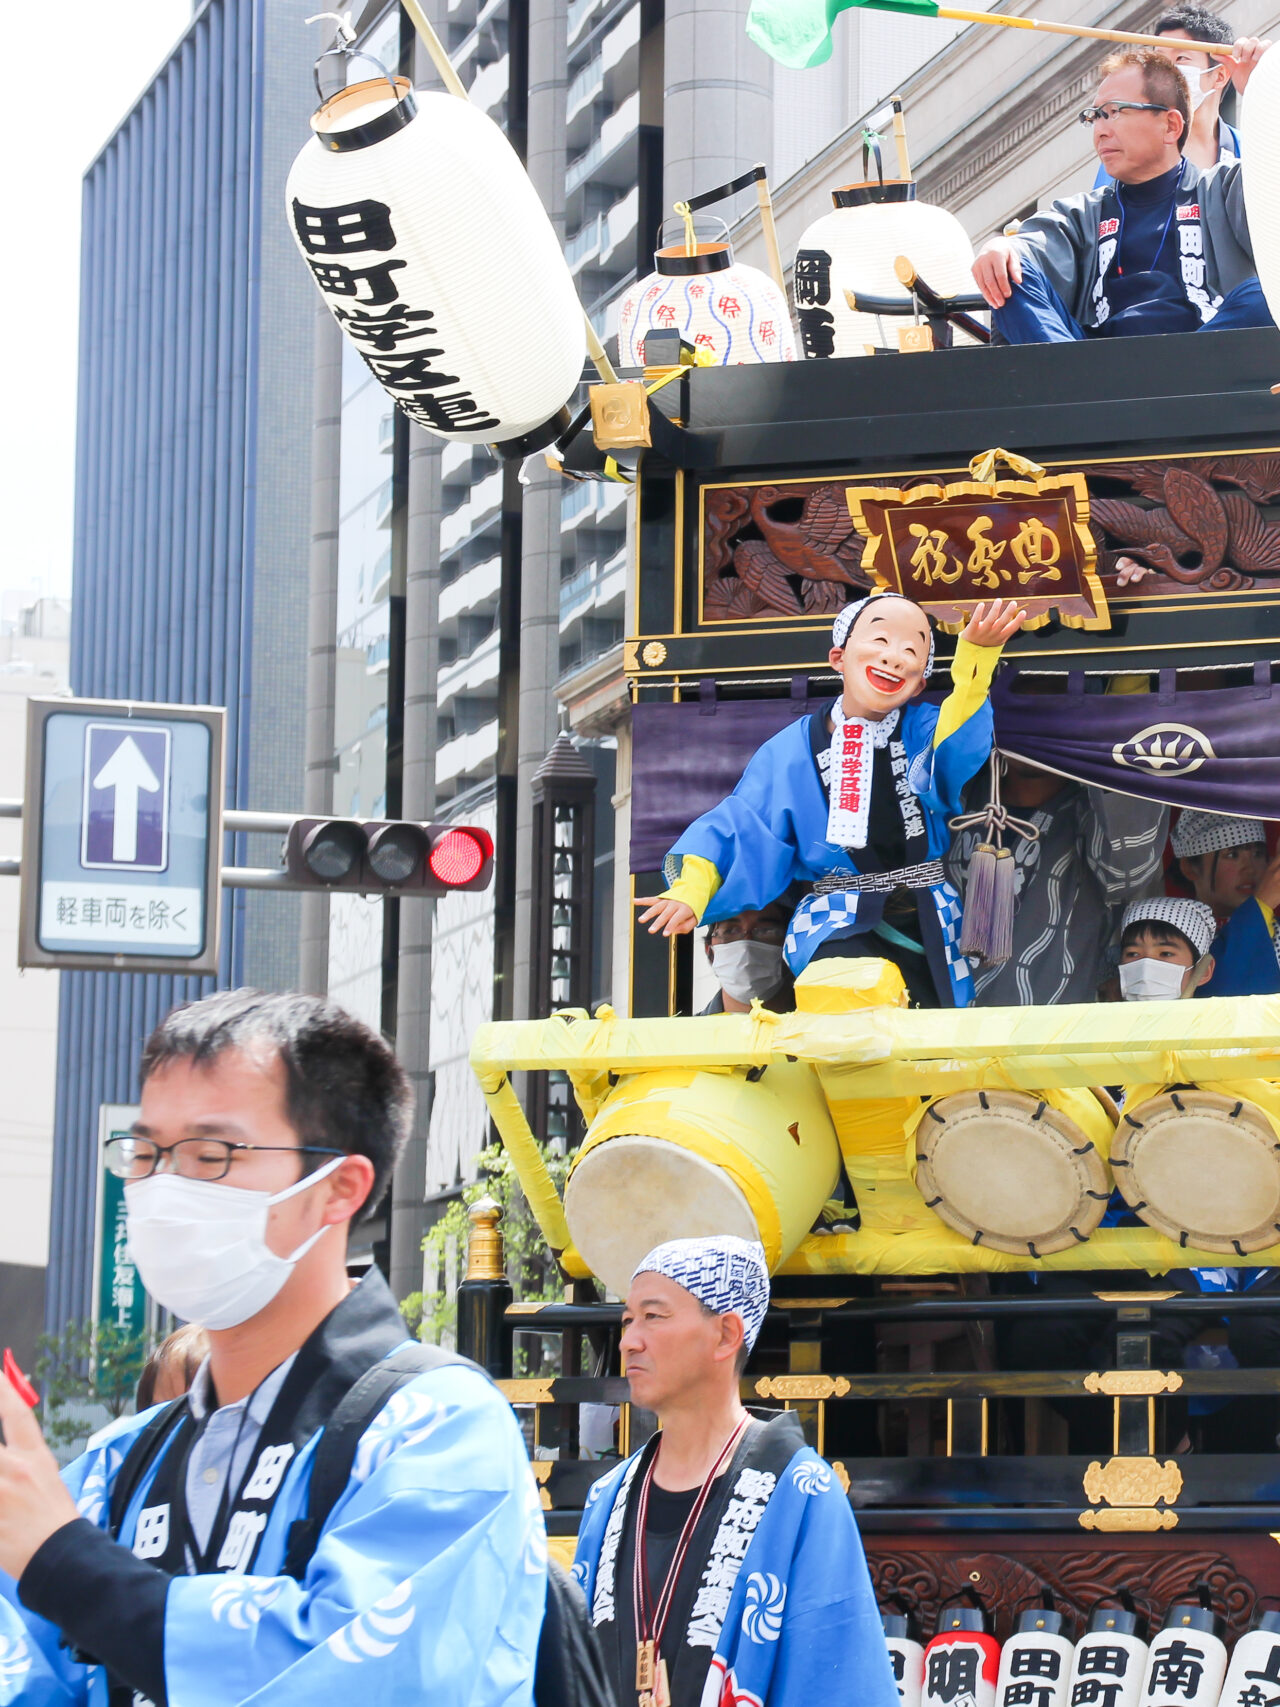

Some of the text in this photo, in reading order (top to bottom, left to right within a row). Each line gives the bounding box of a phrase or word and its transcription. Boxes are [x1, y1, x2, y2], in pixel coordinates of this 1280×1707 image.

[718, 296, 741, 319] 祭
[839, 724, 864, 813] 田町学区連
[56, 895, 188, 931] 軽車両を除く
[928, 1648, 979, 1703] 明
[1148, 1640, 1204, 1699] 南
